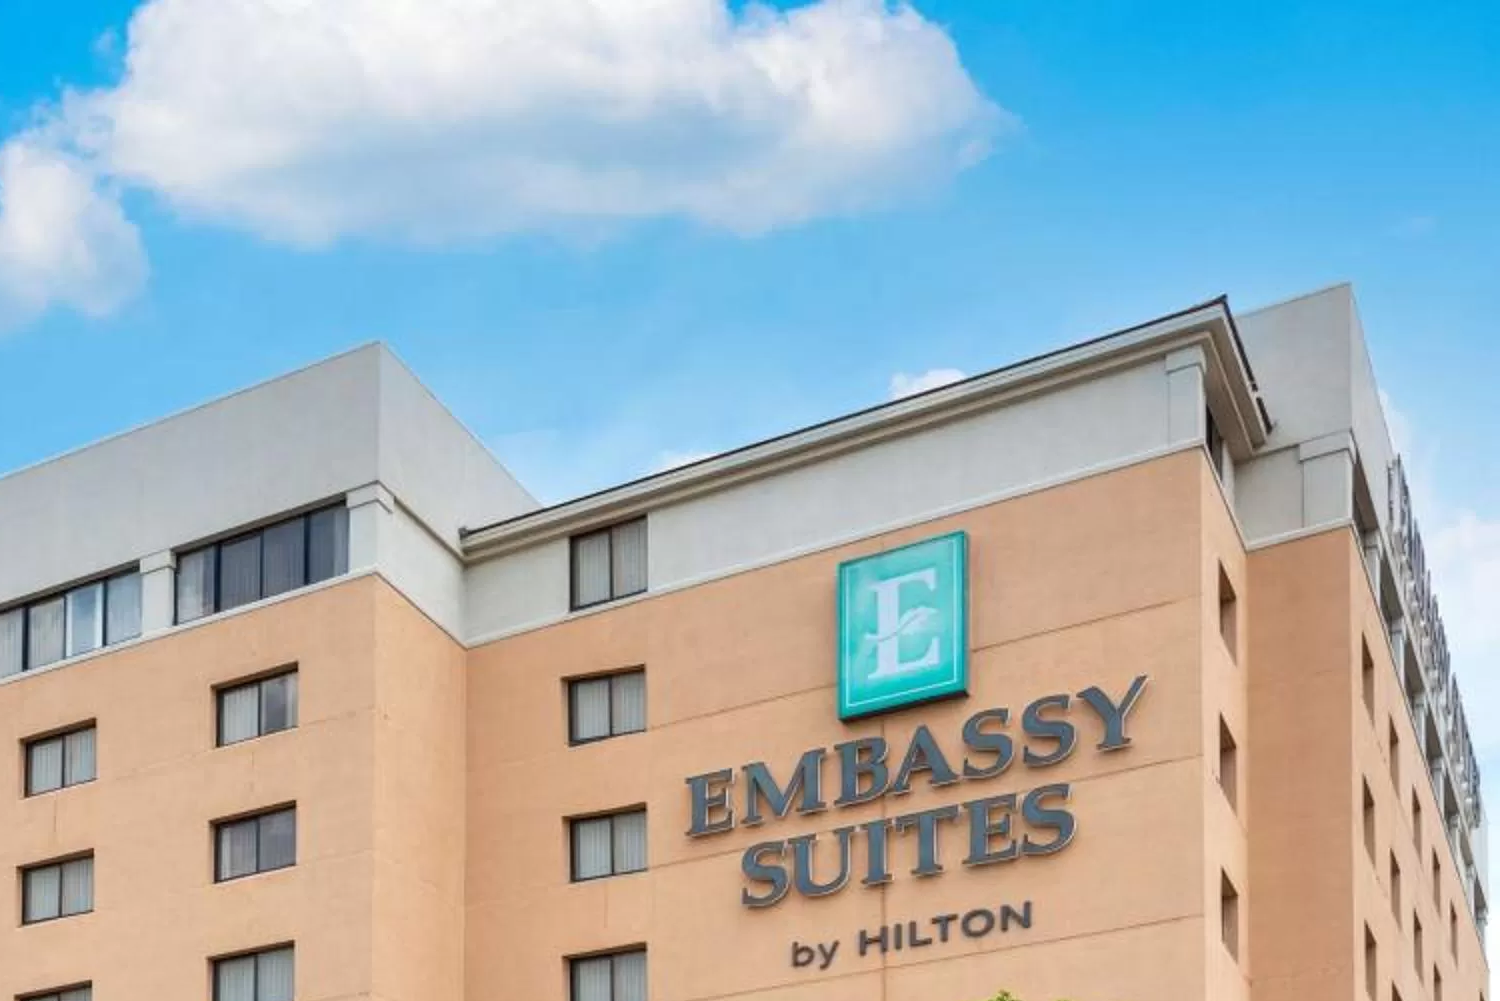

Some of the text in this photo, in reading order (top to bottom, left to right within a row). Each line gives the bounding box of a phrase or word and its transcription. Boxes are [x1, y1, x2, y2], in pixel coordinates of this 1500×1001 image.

[865, 568, 940, 680] E
[685, 674, 1148, 838] EMBASSY
[741, 783, 1078, 909] SUITES
[791, 901, 1033, 970] by HILTON
